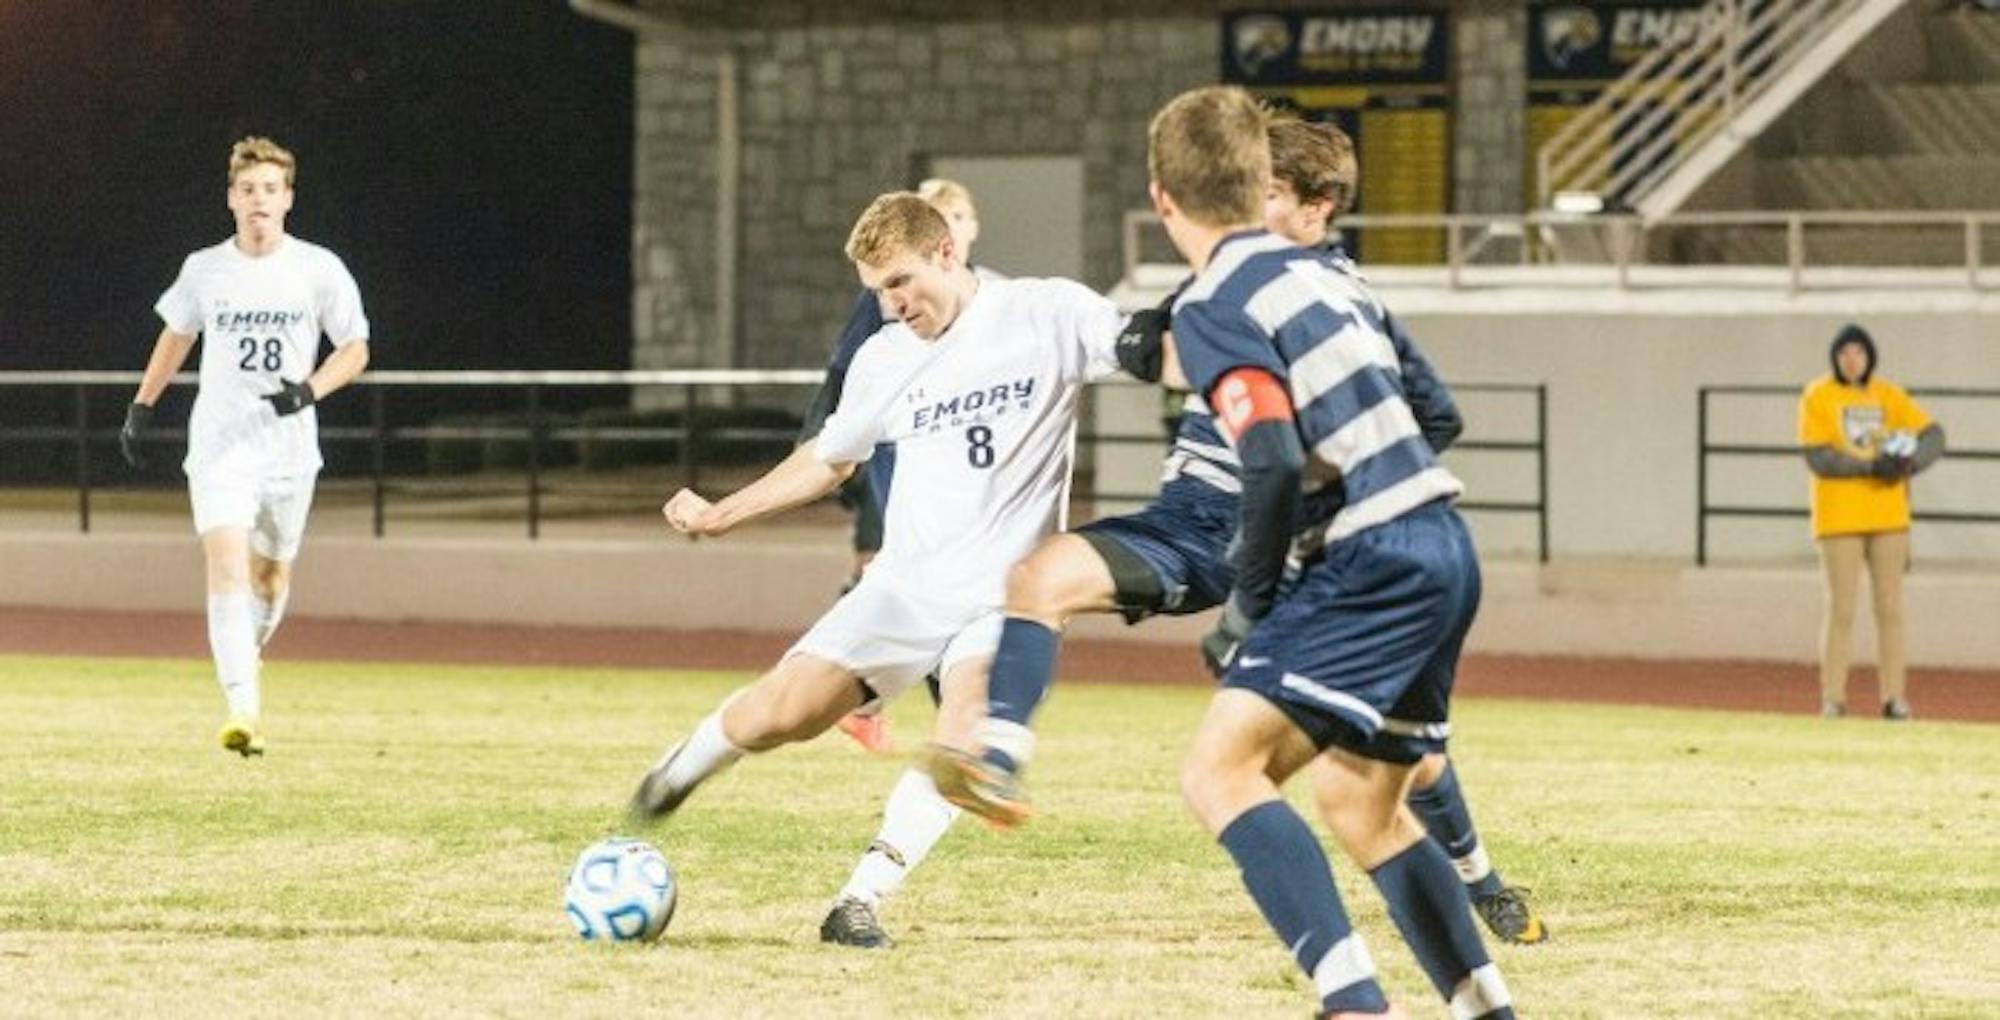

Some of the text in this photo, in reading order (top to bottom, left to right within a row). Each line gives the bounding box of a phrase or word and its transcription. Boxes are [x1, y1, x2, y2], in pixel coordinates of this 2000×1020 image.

[1301, 17, 1435, 51] EMORY
[216, 310, 304, 326] EMORY
[239, 337, 282, 372] 28
[913, 377, 1035, 429] EMORY
[966, 425, 995, 469] 8
